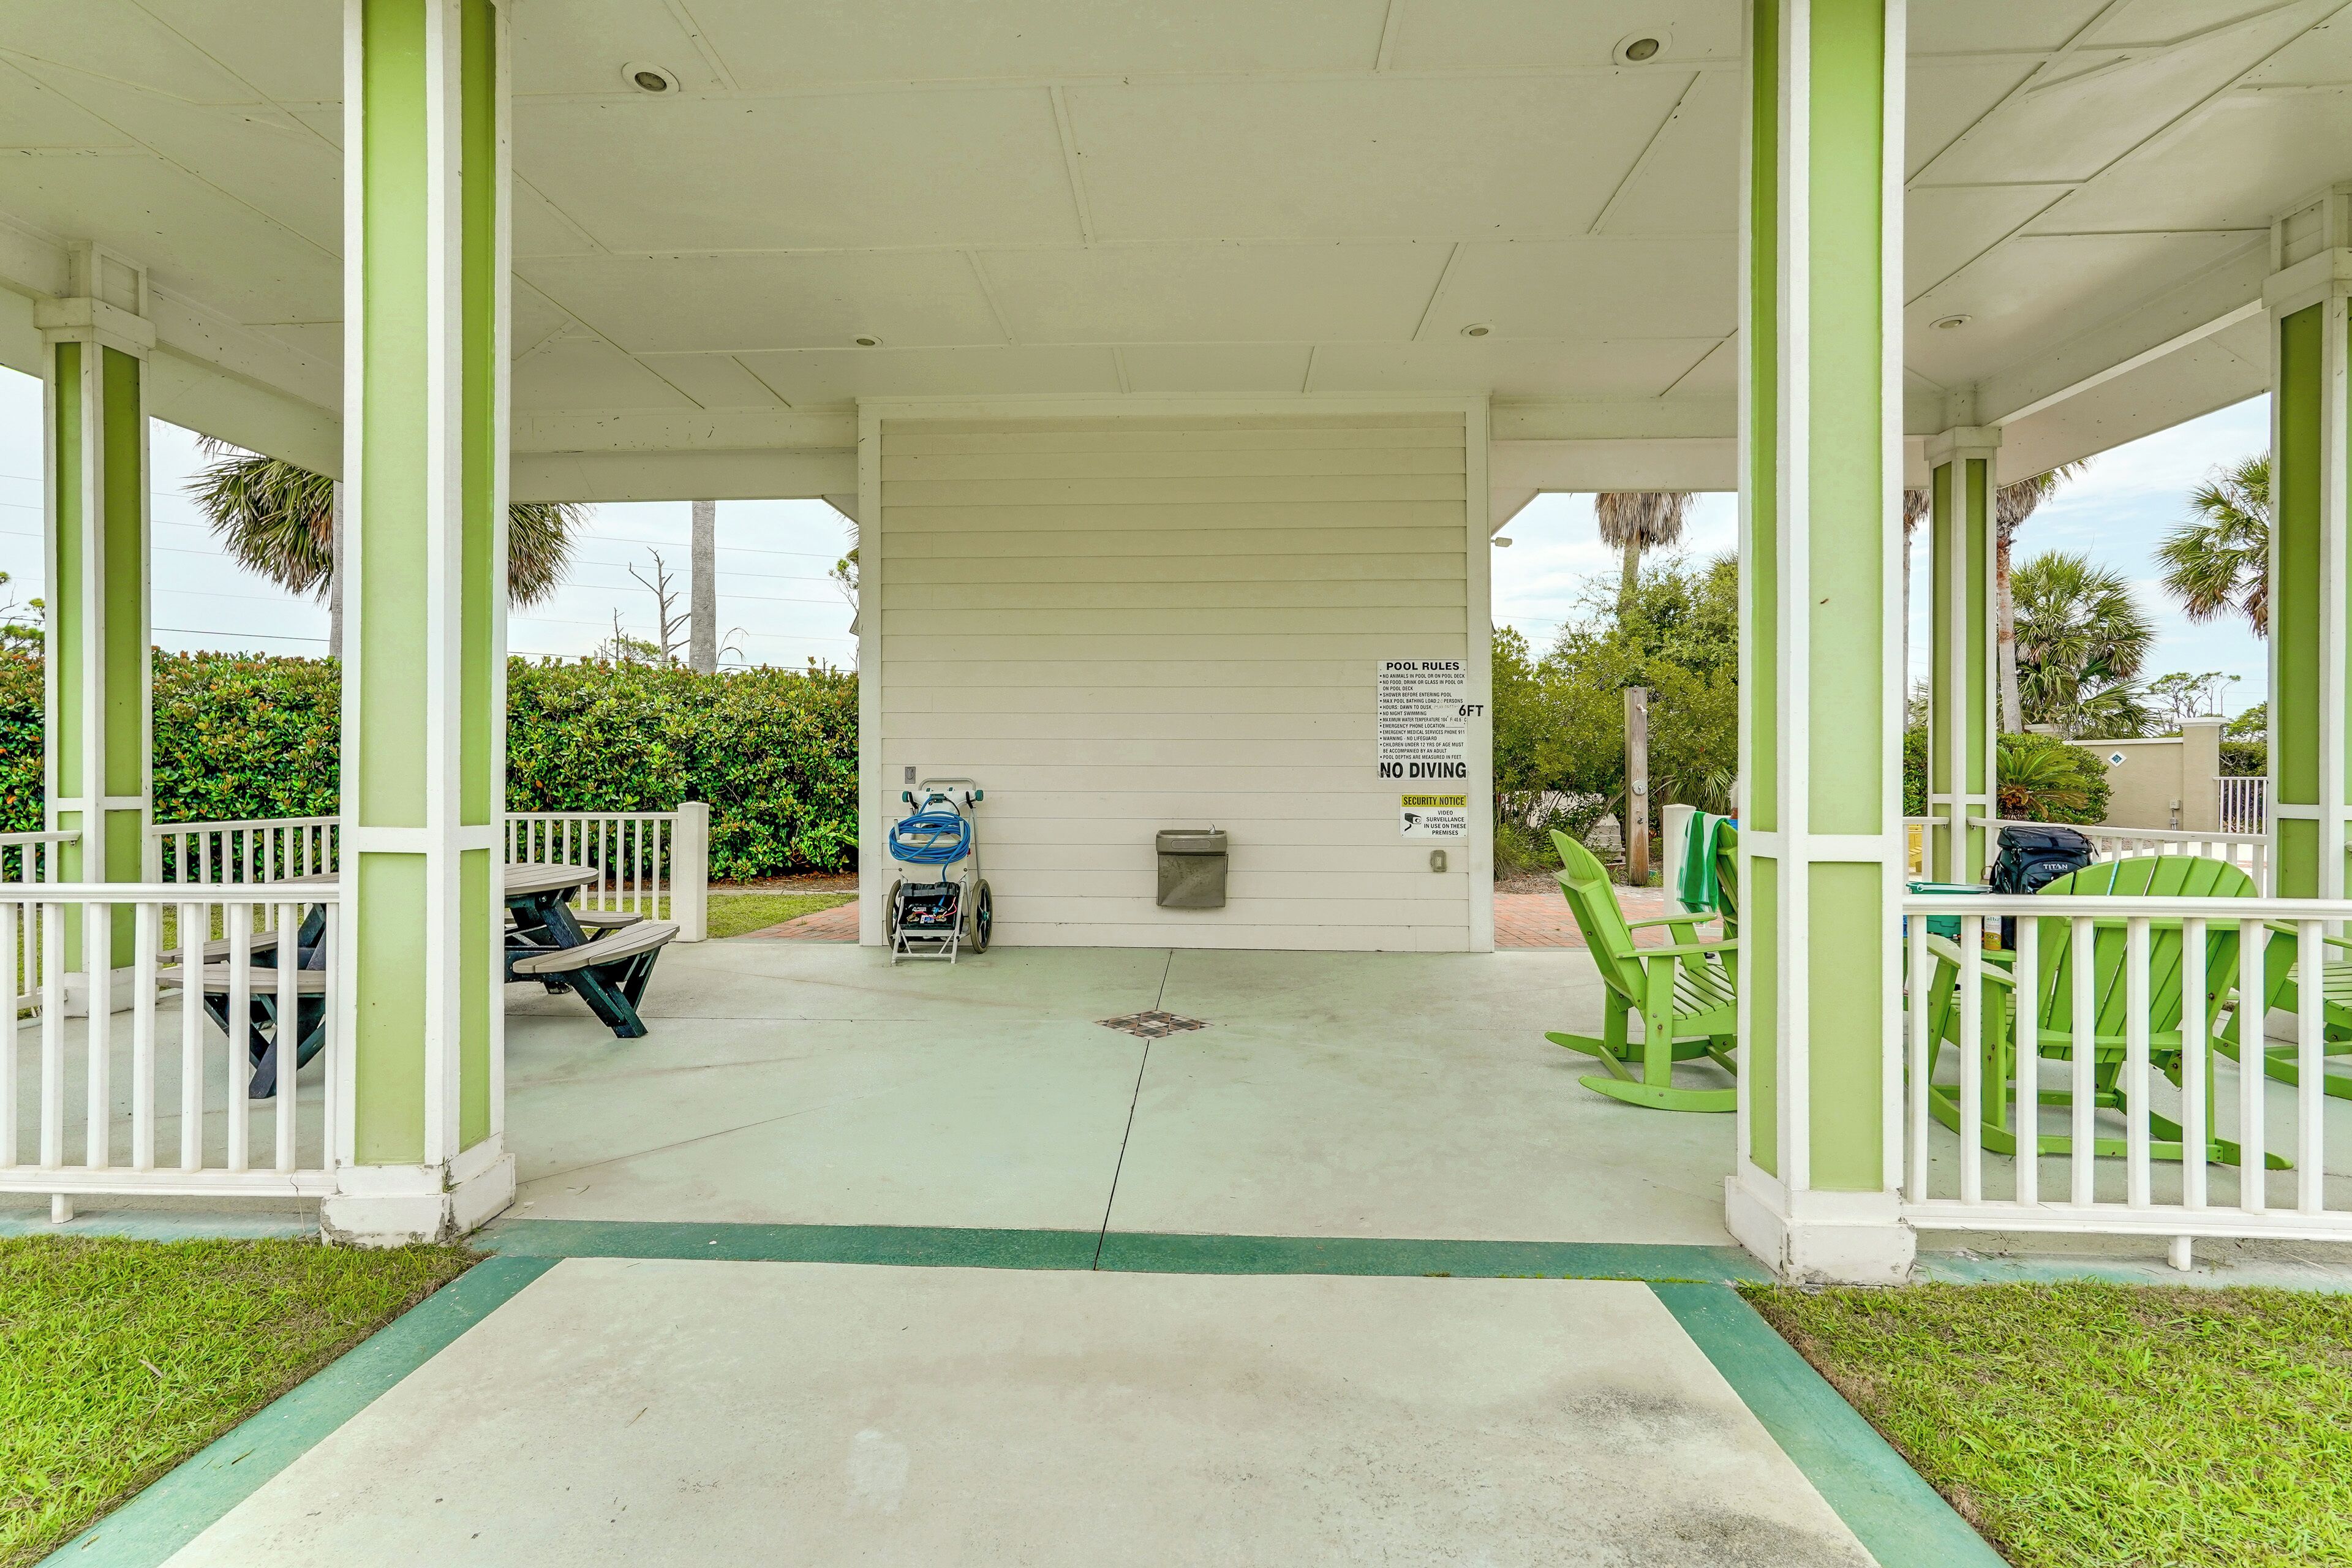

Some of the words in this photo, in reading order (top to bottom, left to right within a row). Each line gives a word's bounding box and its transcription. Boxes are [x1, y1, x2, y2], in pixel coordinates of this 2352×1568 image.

[1459, 704, 1483, 716] 6FT
[1380, 762, 1403, 778] NO
[1409, 762, 1466, 778] DIVING
